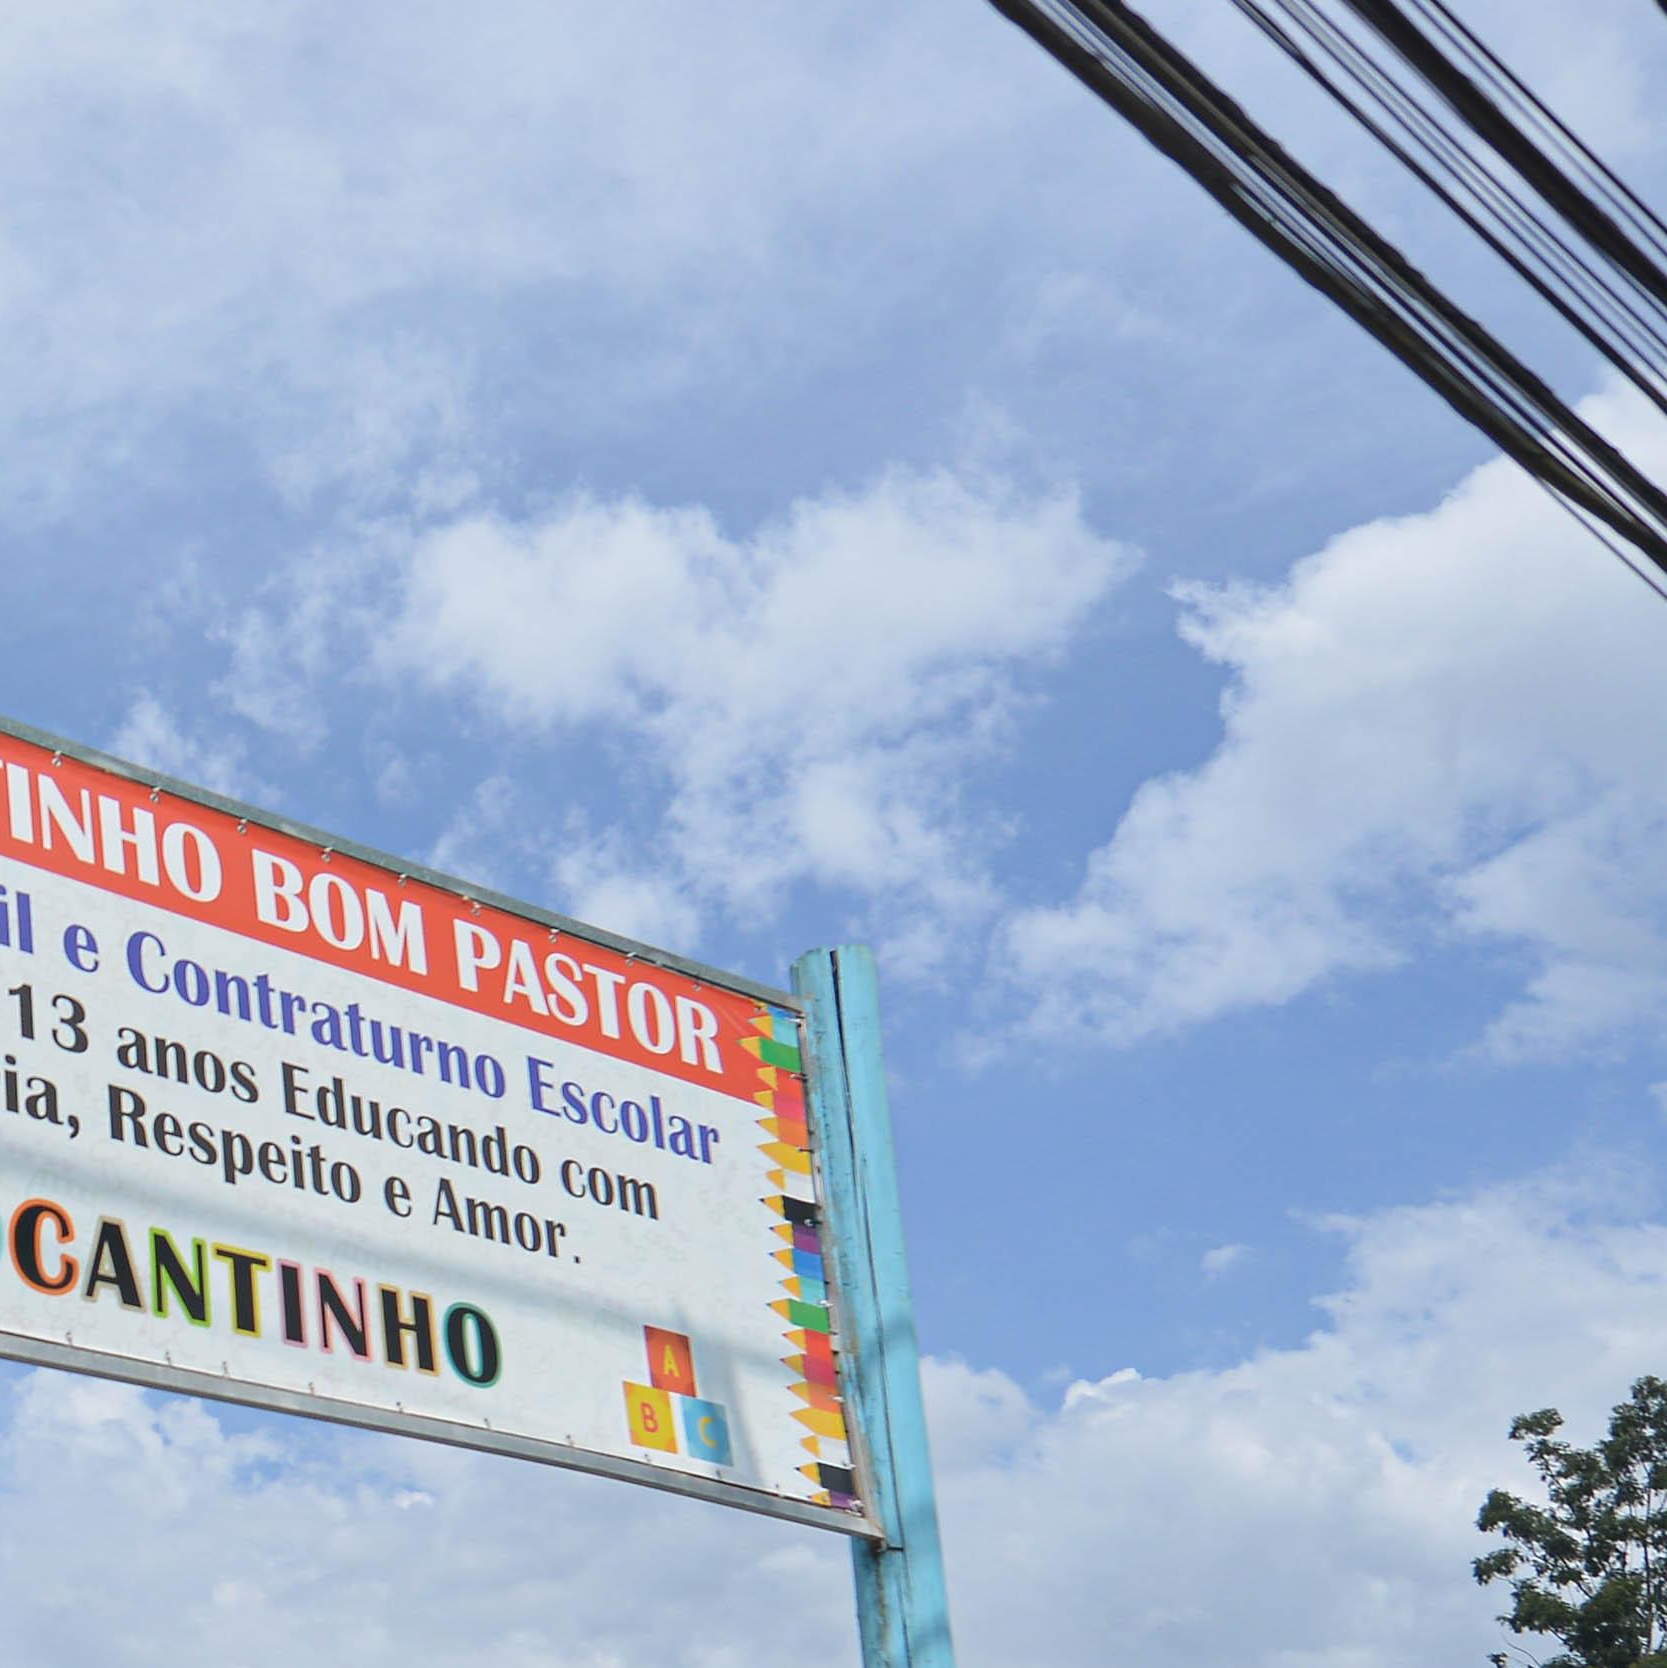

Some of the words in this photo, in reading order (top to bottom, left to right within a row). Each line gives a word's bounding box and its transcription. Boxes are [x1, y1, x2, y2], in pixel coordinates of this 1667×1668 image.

[64, 918, 99, 973] e
[127, 932, 507, 1099] Contraturno
[526, 1056, 721, 1166] Escolar
[251, 848, 428, 976] BOM
[454, 918, 723, 1074] PASTOR
[8, 985, 89, 1054] 13
[116, 1026, 259, 1104] anos
[281, 1062, 540, 1185] Educando
[561, 1158, 660, 1220] com
[108, 1085, 361, 1204] Respeito
[384, 1177, 413, 1218] e
[431, 1187, 582, 1265] Amor.
[642, 1401, 657, 1433] B
[662, 1346, 678, 1379] A
